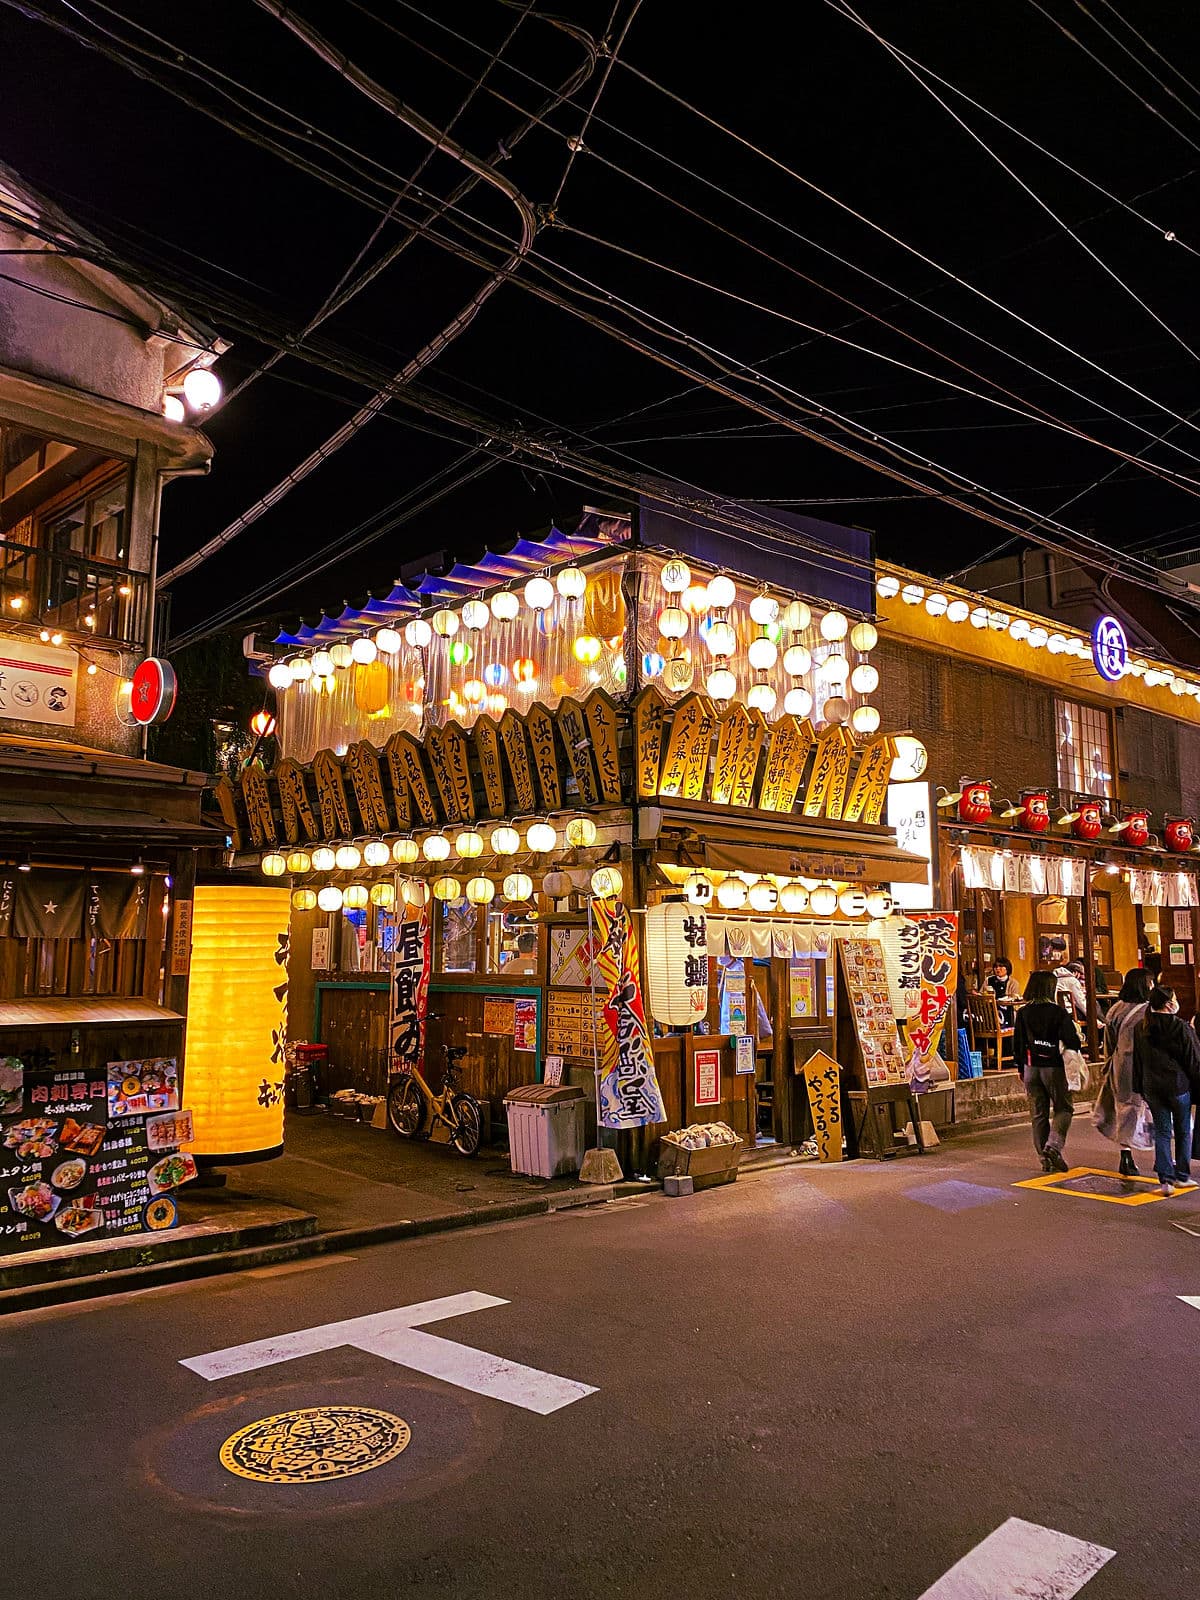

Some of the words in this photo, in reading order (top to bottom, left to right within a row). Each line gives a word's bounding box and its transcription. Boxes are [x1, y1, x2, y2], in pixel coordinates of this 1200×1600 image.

[664, 705, 696, 793] 恋人募集中
[135, 886, 145, 915] レバー
[682, 915, 708, 987] 牡蠣
[824, 1066, 840, 1124] やってる
